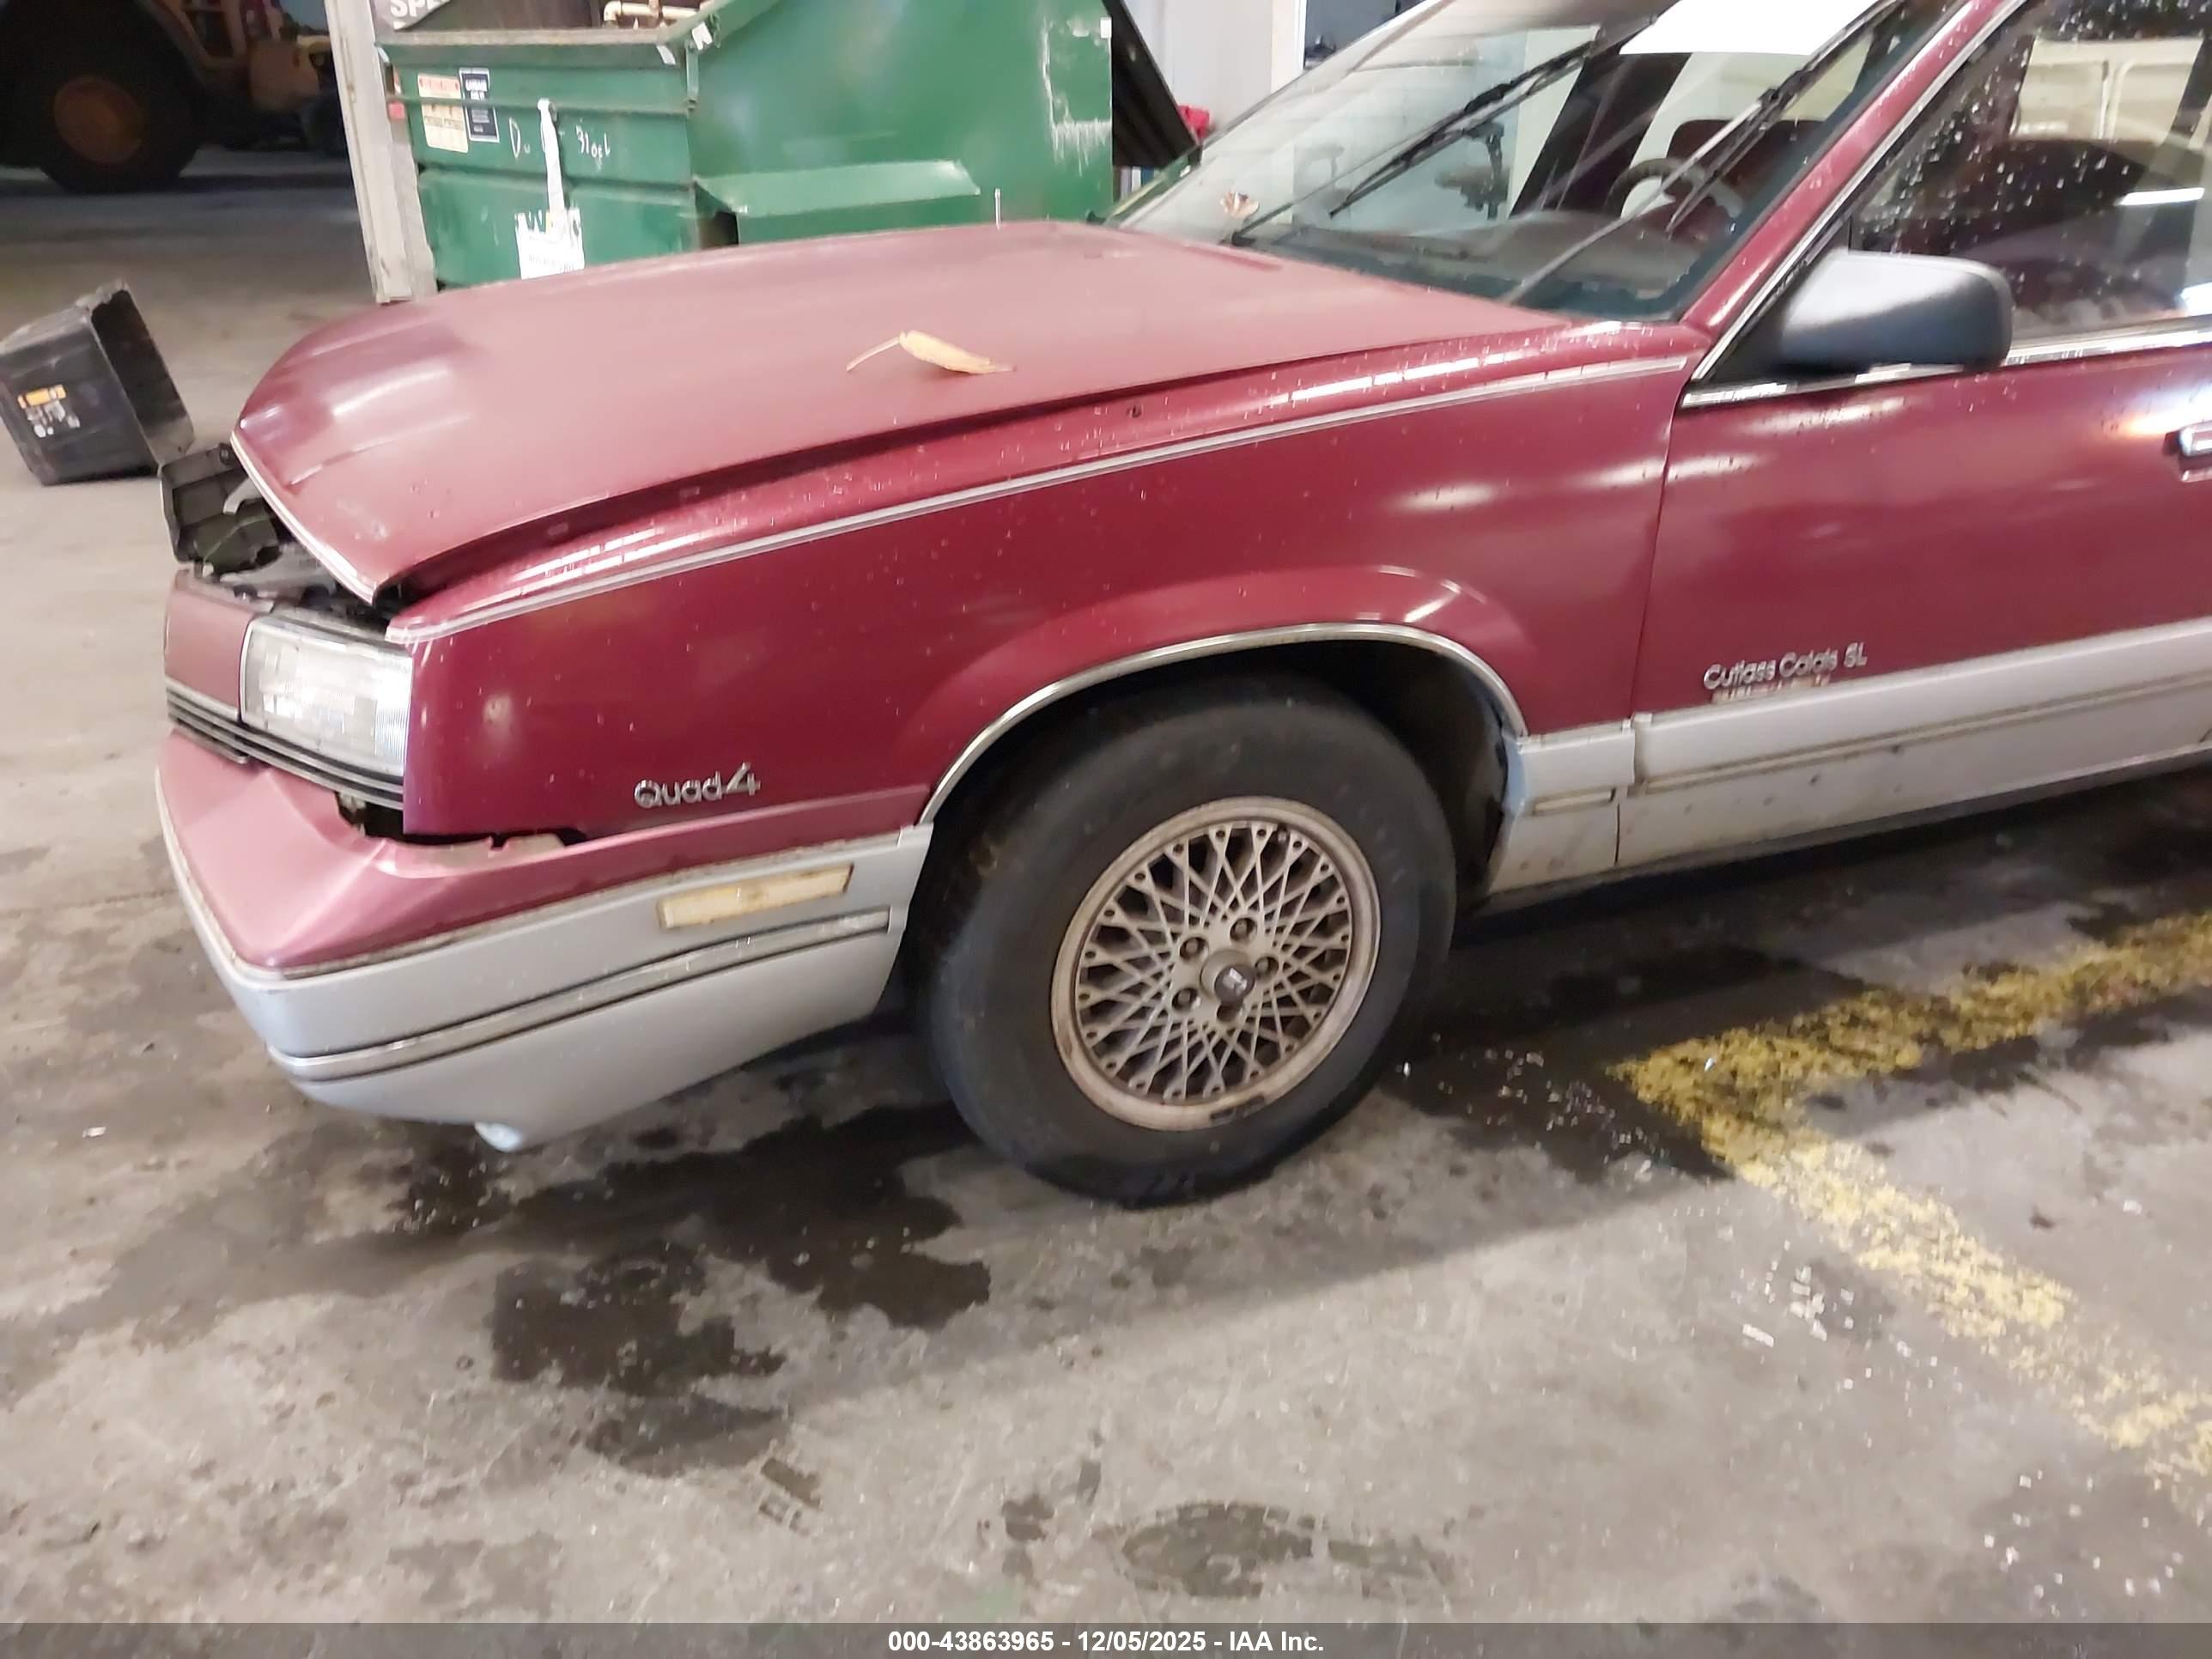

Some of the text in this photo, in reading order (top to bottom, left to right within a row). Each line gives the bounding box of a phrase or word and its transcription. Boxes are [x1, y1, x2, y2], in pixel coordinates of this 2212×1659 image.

[1704, 659, 1776, 690] Cutlass
[1779, 648, 1838, 678] Calais
[1844, 642, 1869, 667] SL
